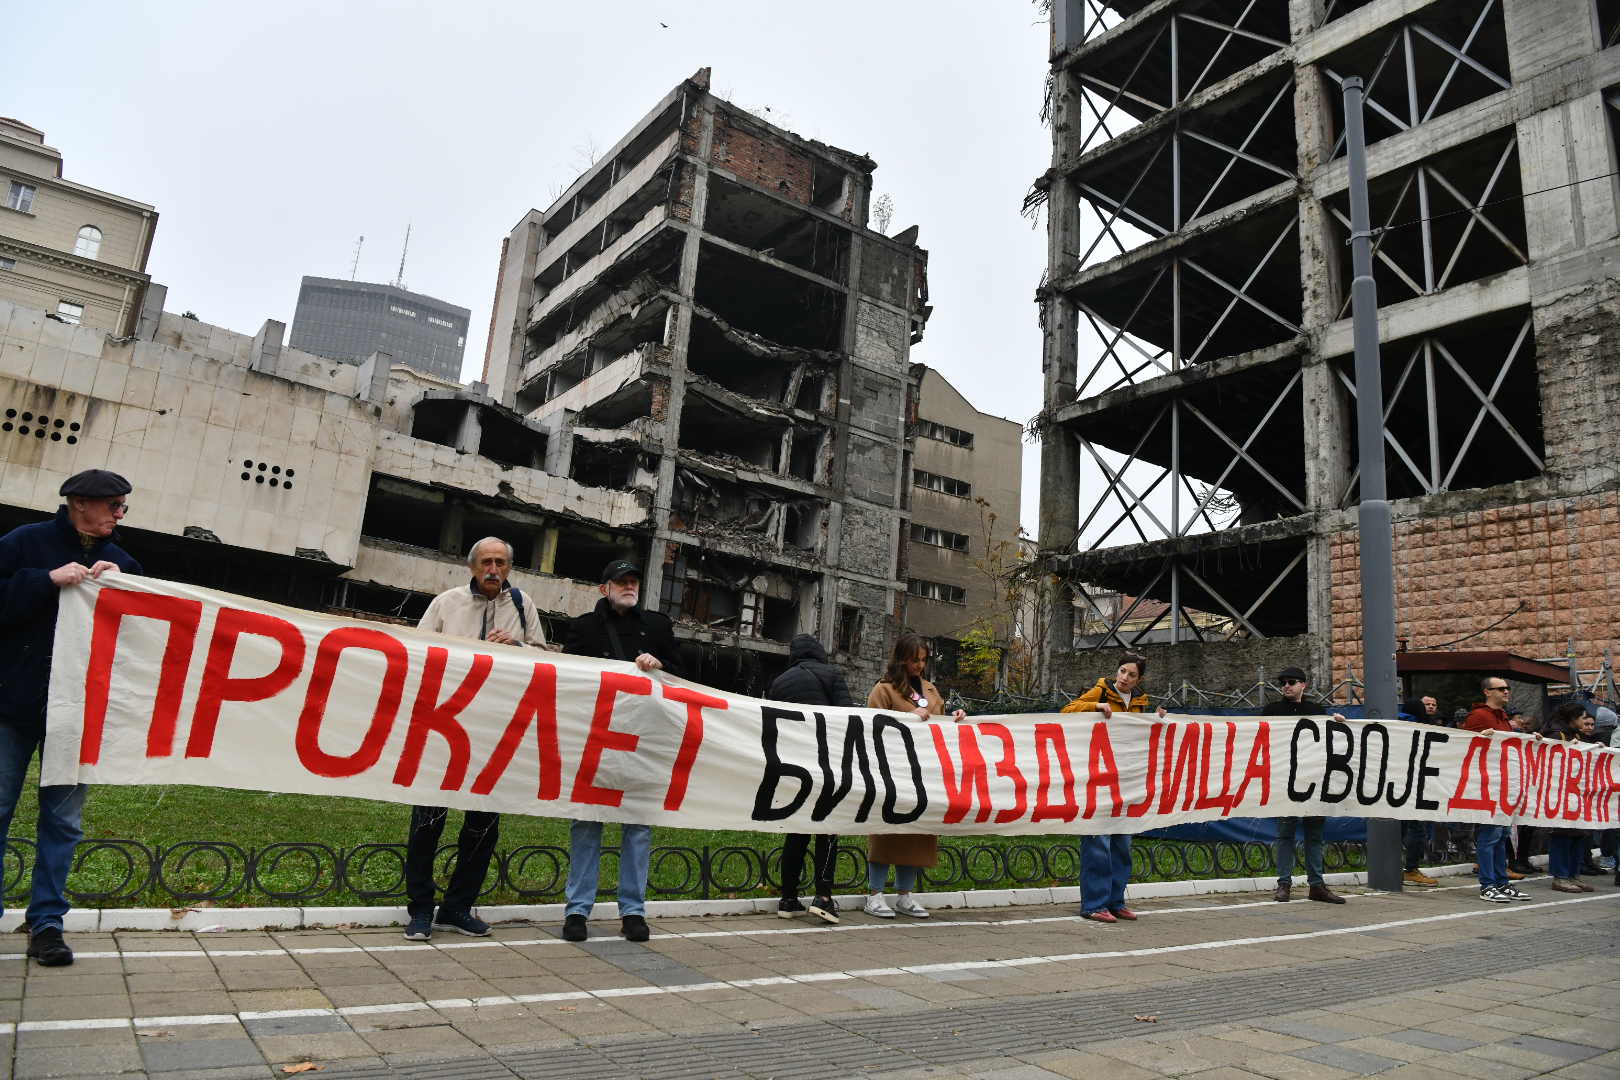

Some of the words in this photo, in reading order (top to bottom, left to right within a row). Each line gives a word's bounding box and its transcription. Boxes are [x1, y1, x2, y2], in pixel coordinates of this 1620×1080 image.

[80, 588, 728, 811] ПРОКЛЕТ
[751, 706, 927, 824] БИО
[929, 721, 1271, 824] ИЗДАЈИЦА
[1287, 718, 1449, 810] СВОЈЕ
